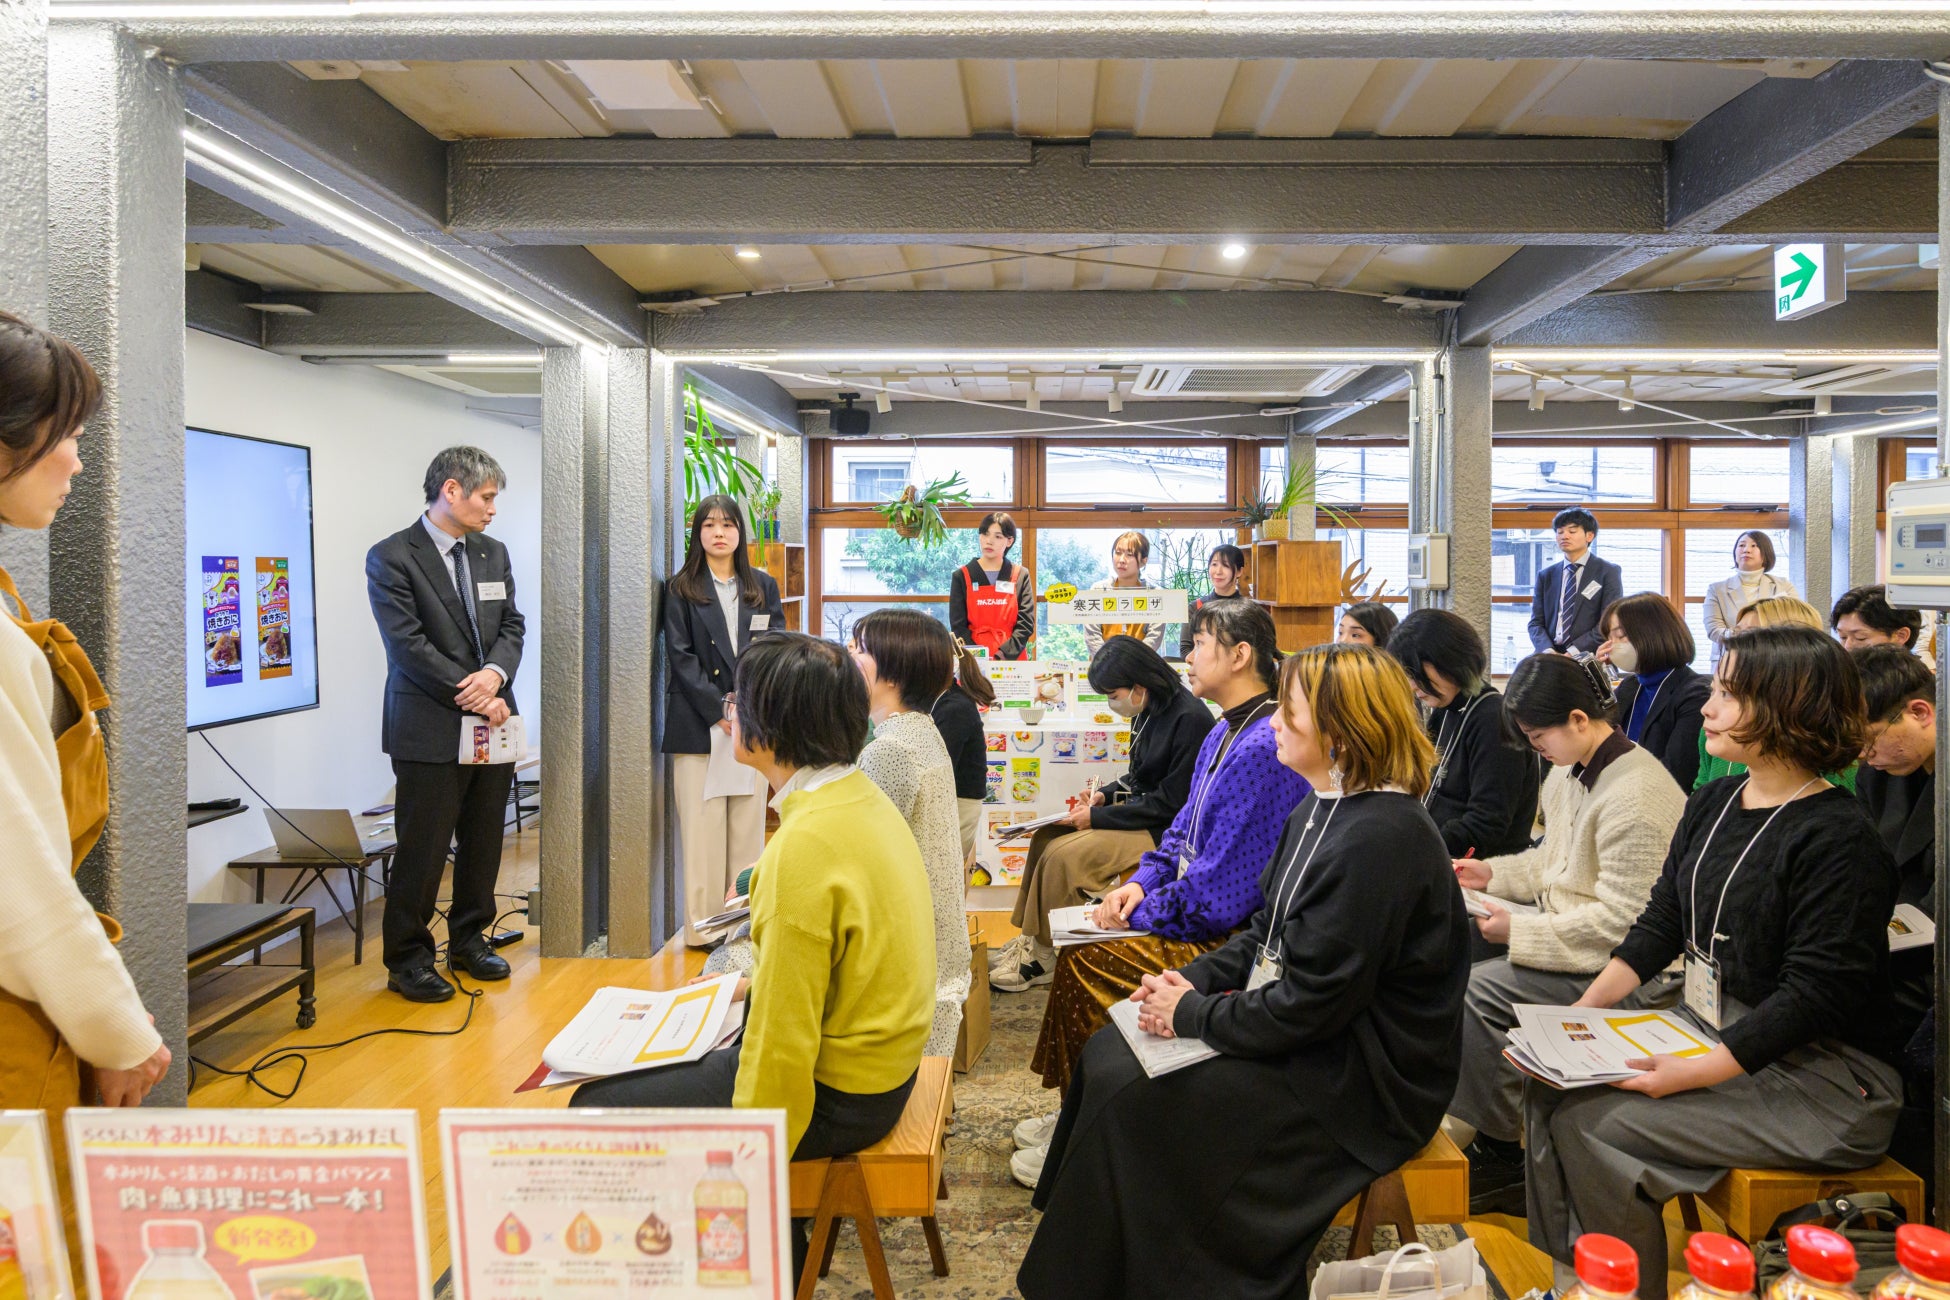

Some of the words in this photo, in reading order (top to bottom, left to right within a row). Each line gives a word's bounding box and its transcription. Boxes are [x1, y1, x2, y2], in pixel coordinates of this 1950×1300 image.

[1074, 597, 1162, 611] 寒天ウラワザ
[207, 614, 239, 630] 焼きおに
